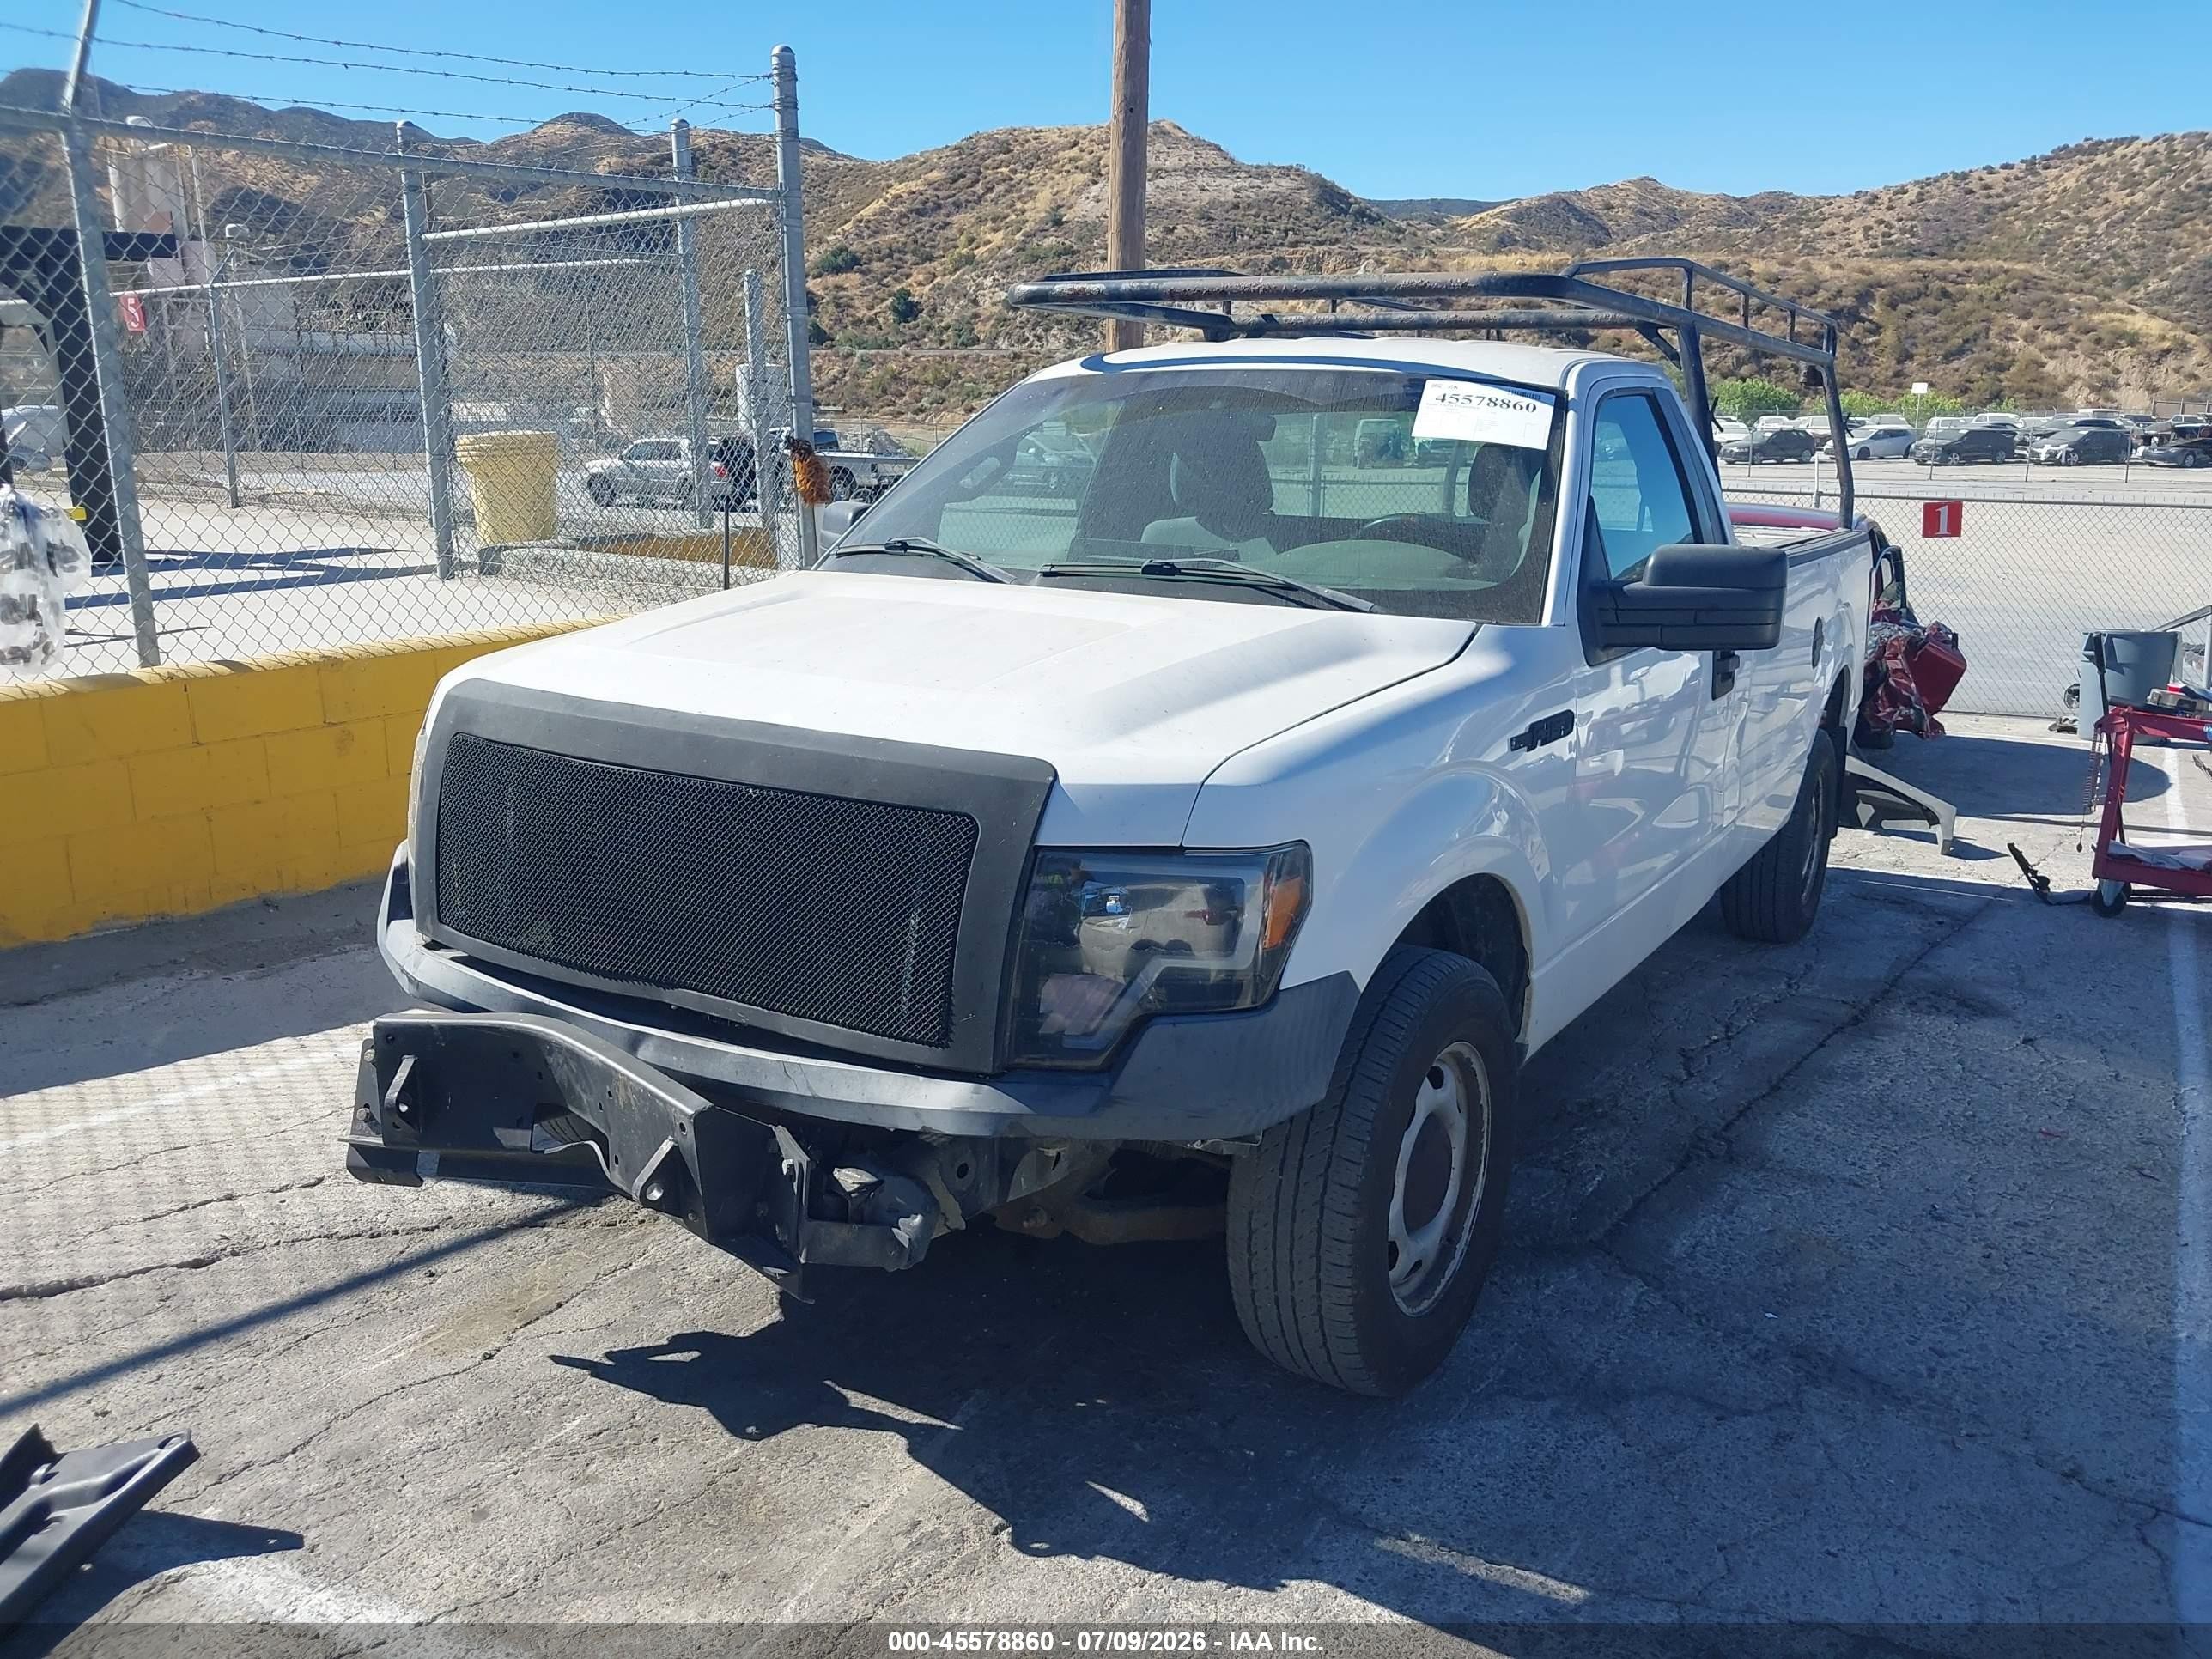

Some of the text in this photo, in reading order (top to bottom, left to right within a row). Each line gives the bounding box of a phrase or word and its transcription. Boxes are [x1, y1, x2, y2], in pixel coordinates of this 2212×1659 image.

[127, 297, 140, 328] 5
[1435, 392, 1537, 413] 45578860
[1935, 505, 1952, 535] 1
